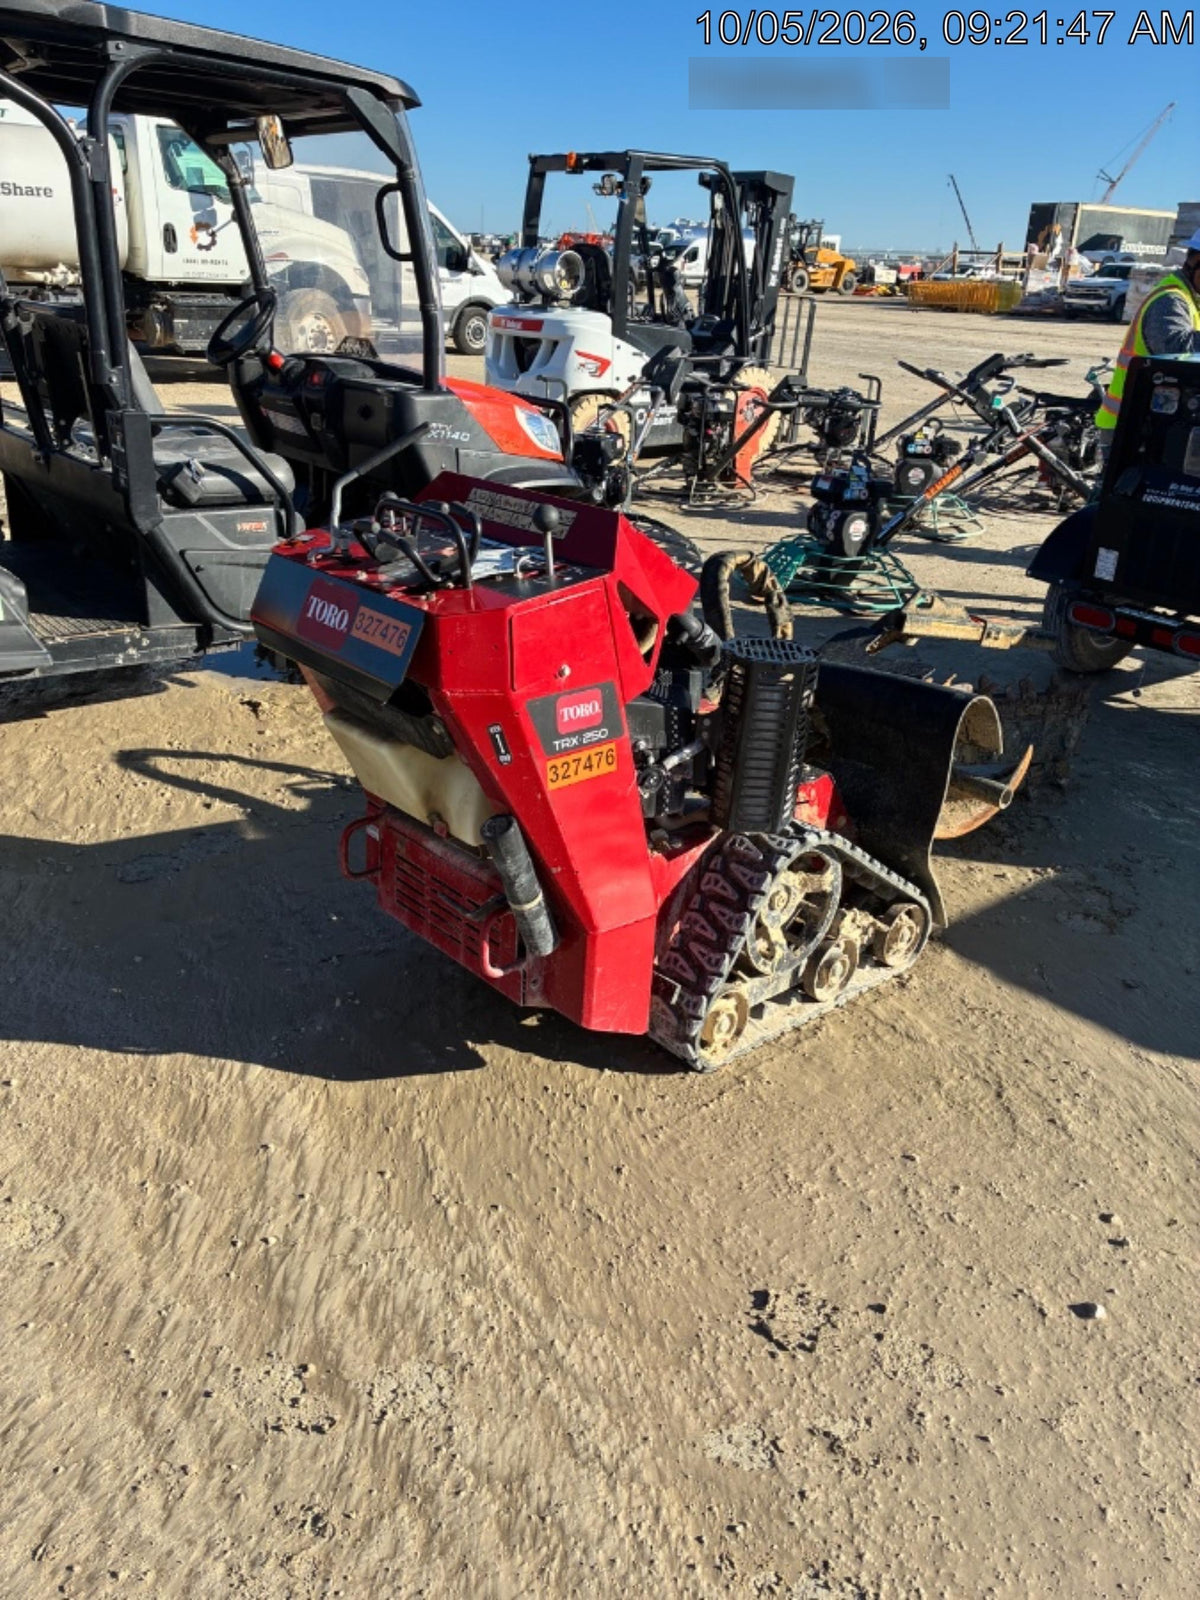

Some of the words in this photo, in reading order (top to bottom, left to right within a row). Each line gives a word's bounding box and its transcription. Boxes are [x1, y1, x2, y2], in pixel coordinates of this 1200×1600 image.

[0, 182, 53, 198] Share
[307, 595, 350, 632] TORO
[354, 612, 408, 648] 327476
[560, 700, 601, 722] TORO
[549, 748, 616, 783] 327476
